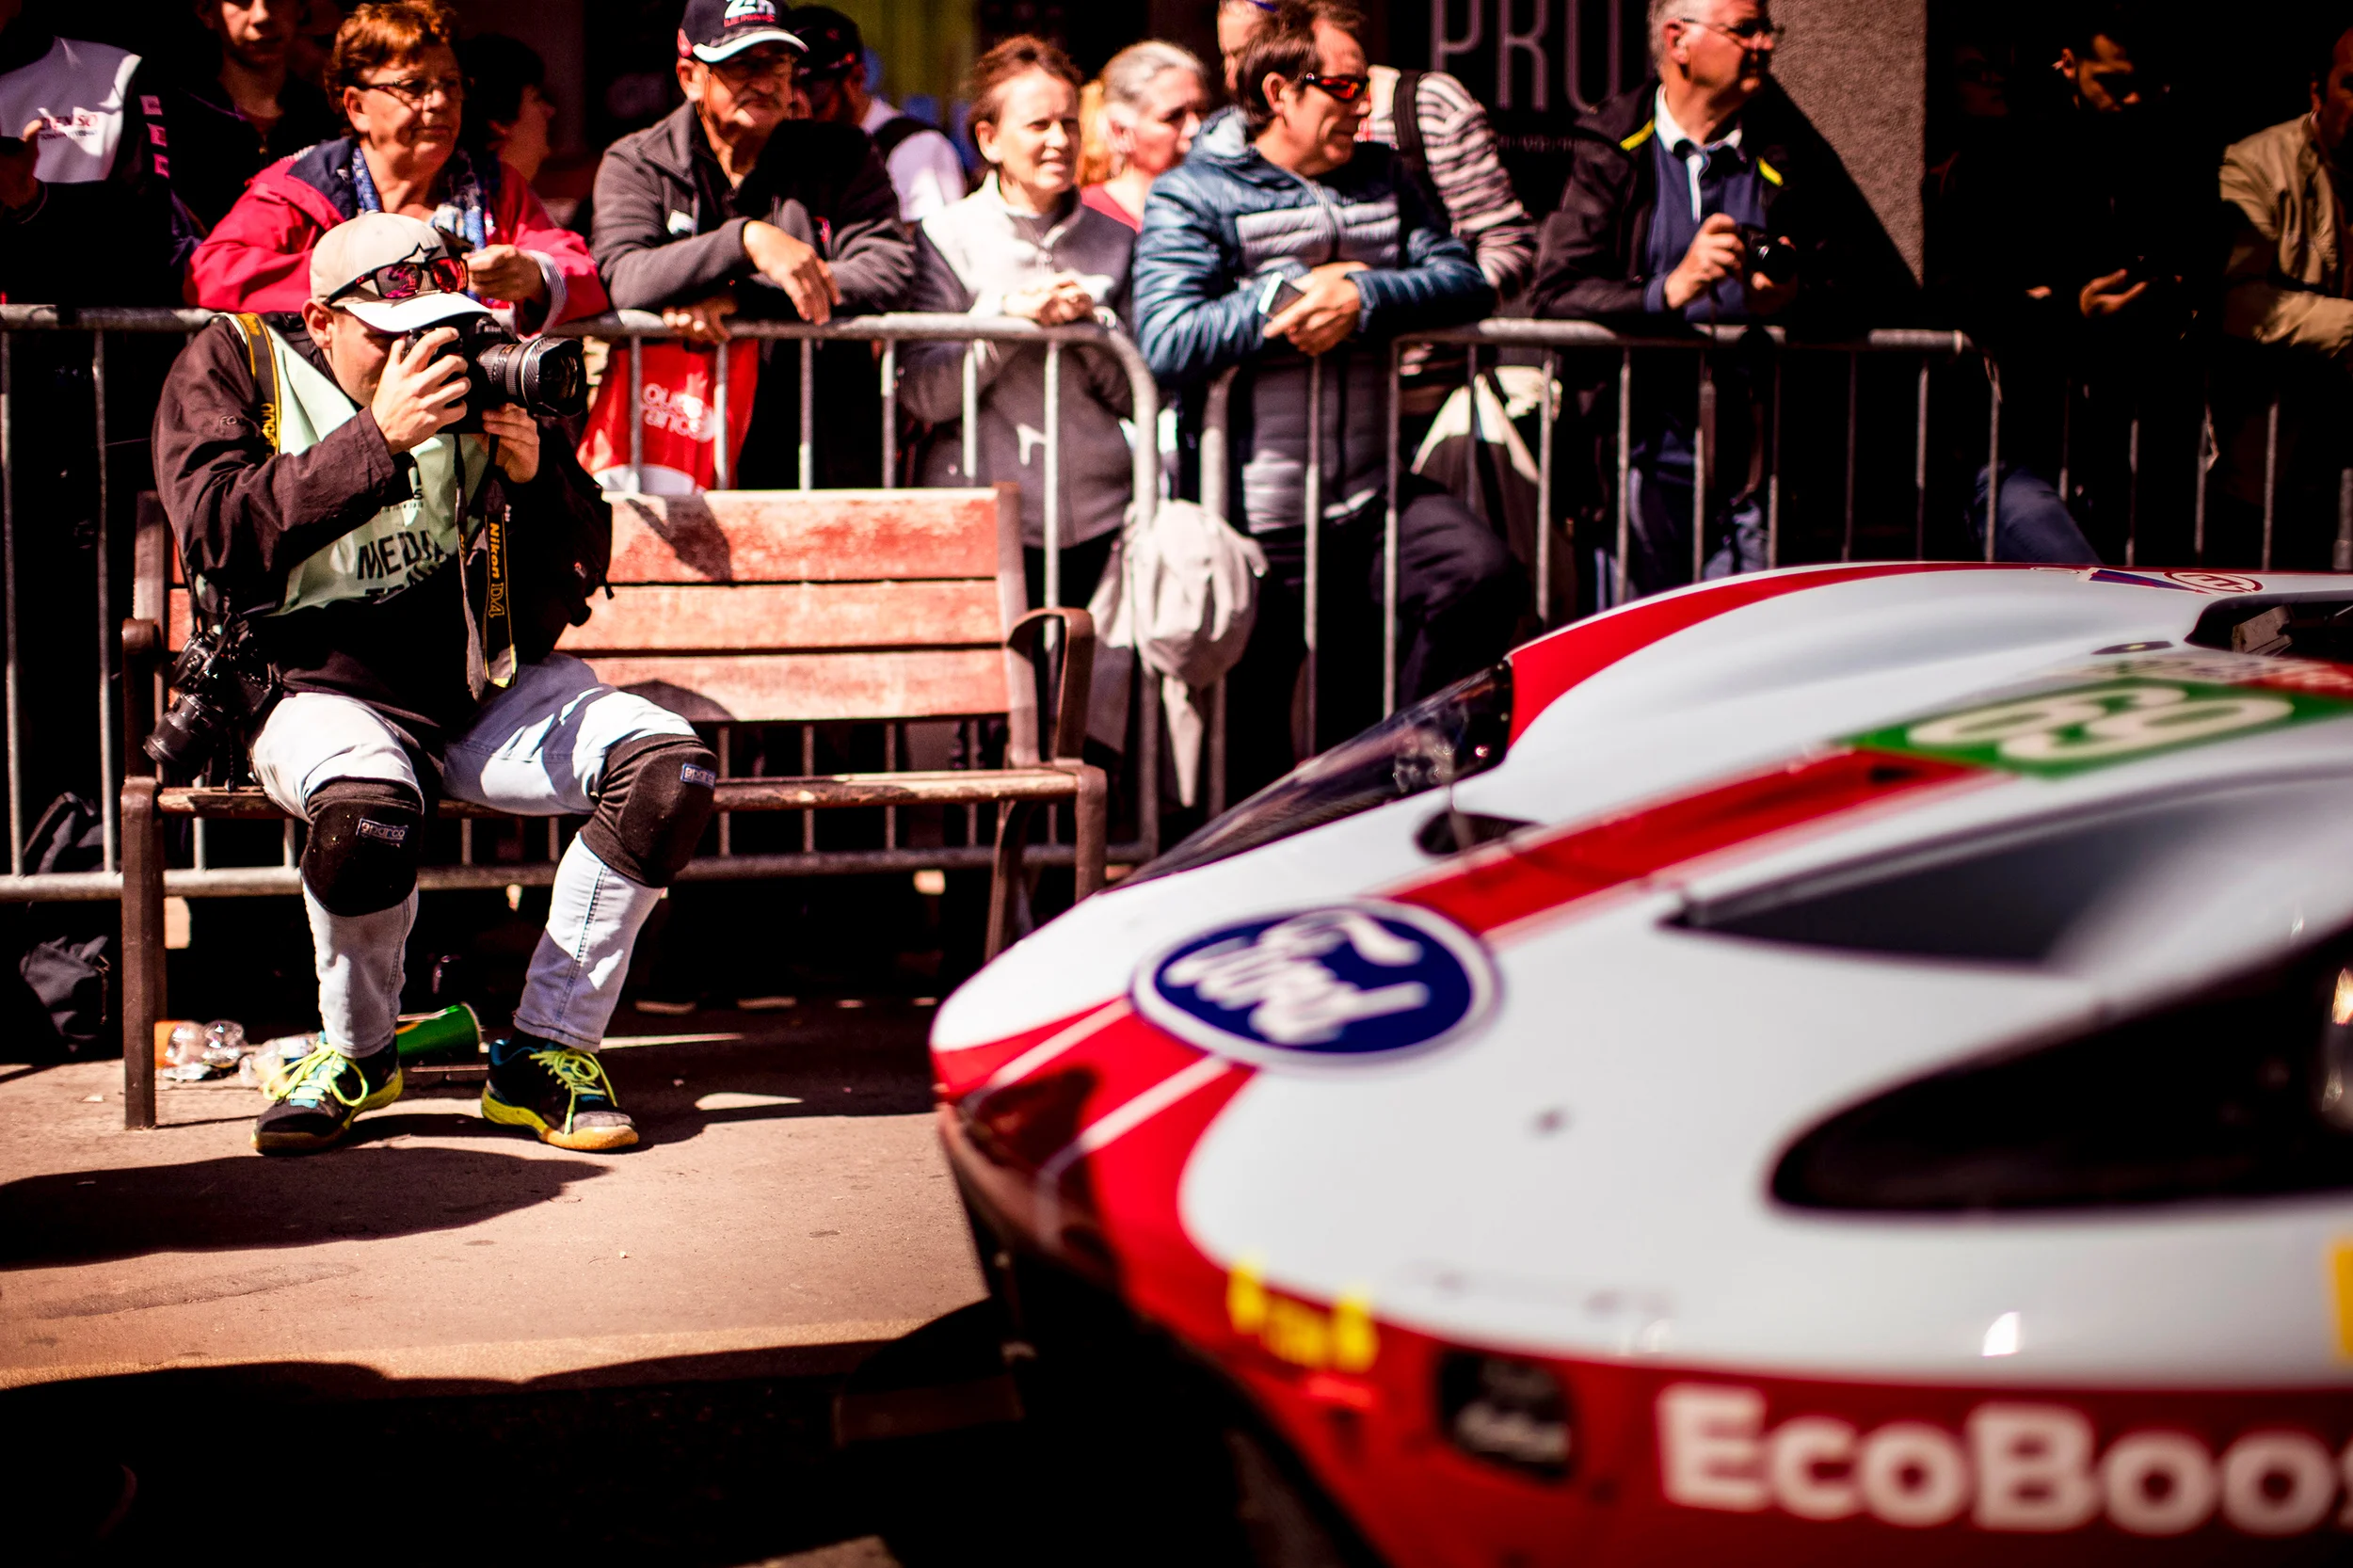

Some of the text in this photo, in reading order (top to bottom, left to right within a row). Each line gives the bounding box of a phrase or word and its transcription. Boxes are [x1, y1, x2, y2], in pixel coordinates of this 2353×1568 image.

[488, 522, 505, 619] Nikon D4
[360, 821, 407, 840] sparco
[1657, 1382, 2353, 1538] EcoBoo
